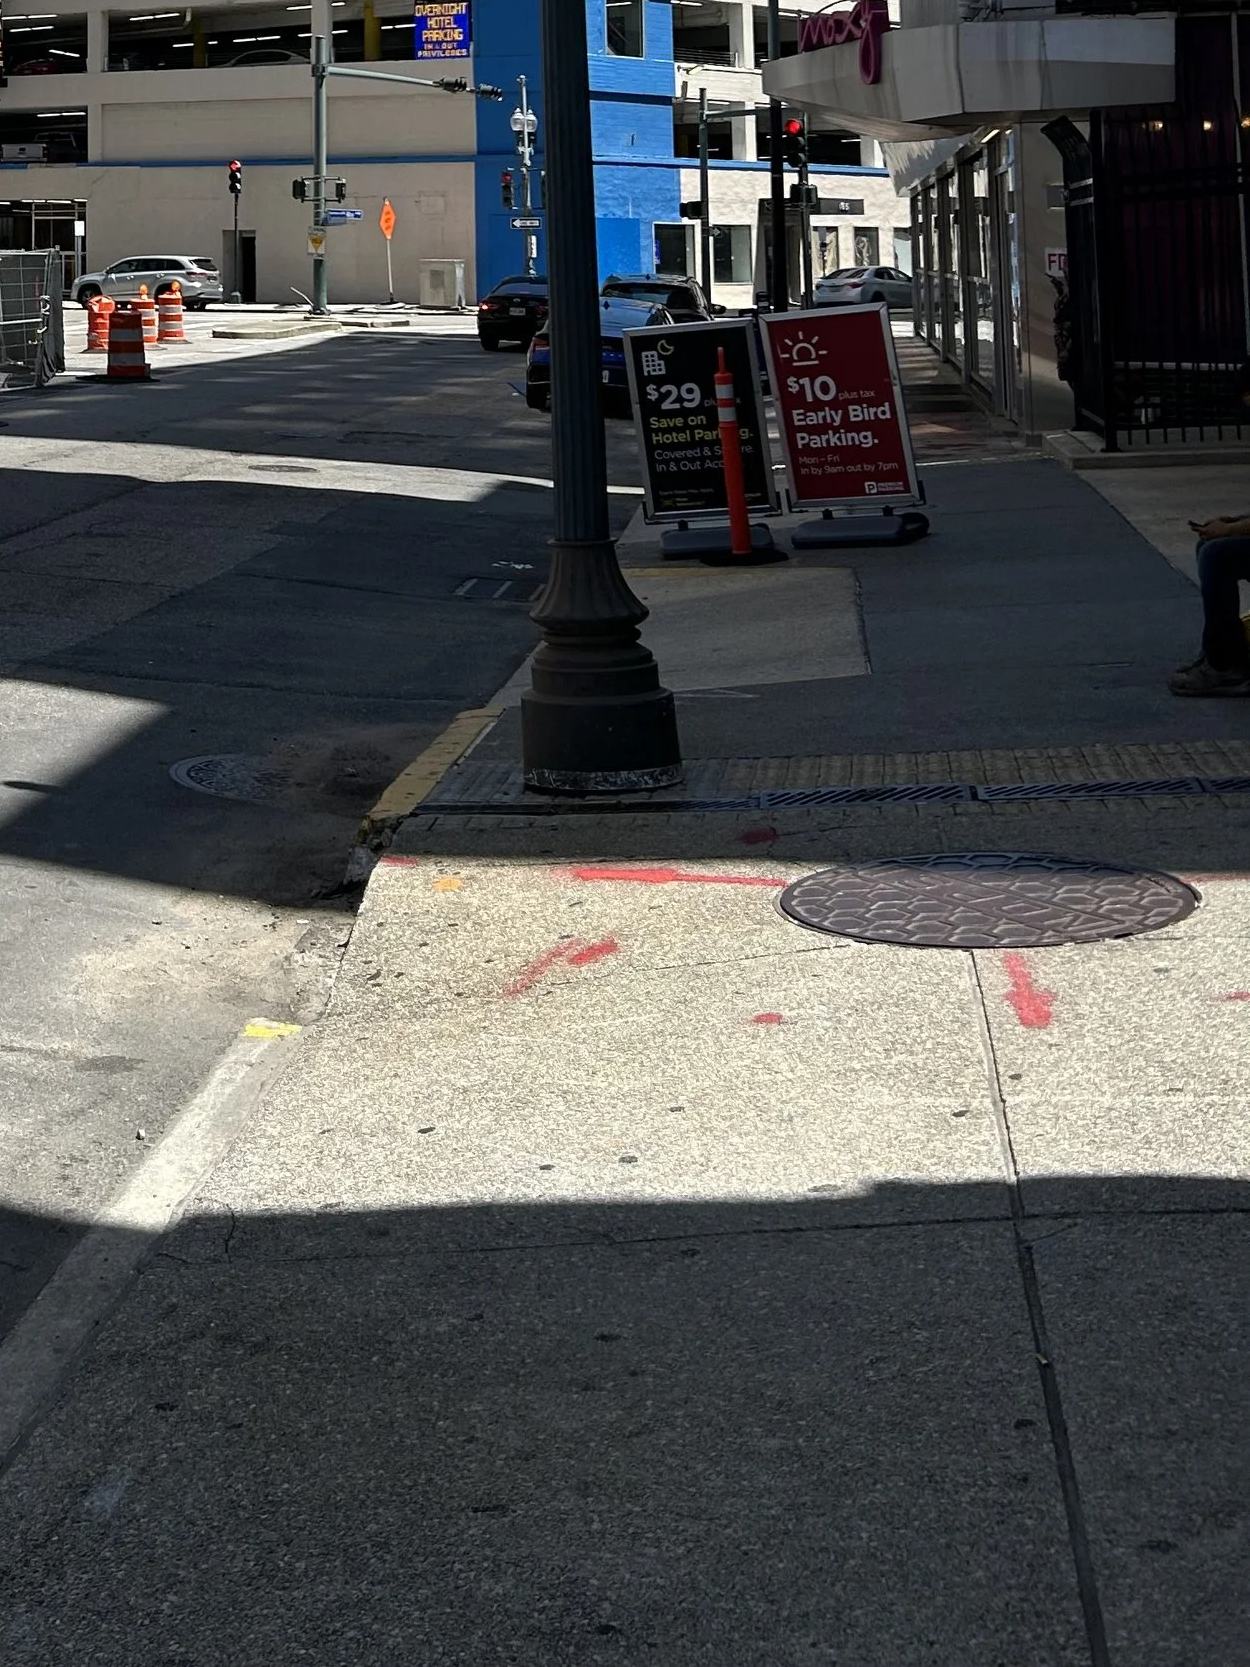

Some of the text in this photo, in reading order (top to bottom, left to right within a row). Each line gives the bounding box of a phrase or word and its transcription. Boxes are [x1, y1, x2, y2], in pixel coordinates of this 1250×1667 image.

[415, 3, 468, 16] OVERNIGHT
[427, 16, 458, 28] HOTEL
[422, 28, 464, 41] PARKING
[787, 375, 876, 402] $10 plus tax
[646, 382, 701, 410] $29
[792, 402, 891, 426] Early Bird
[650, 415, 707, 429] Save on
[652, 429, 691, 445] Hotel
[796, 429, 879, 449] Parking.
[654, 446, 701, 460] Covered
[702, 446, 711, 457] &
[798, 455, 819, 464] Mon
[827, 454, 840, 463] Fri
[655, 462, 667, 472] In
[669, 461, 678, 472] &
[680, 460, 702, 471] Out
[811, 466, 823, 475] by
[824, 464, 845, 474] 9am
[846, 463, 862, 472] out
[863, 462, 876, 472] by
[877, 461, 899, 472] 7pm
